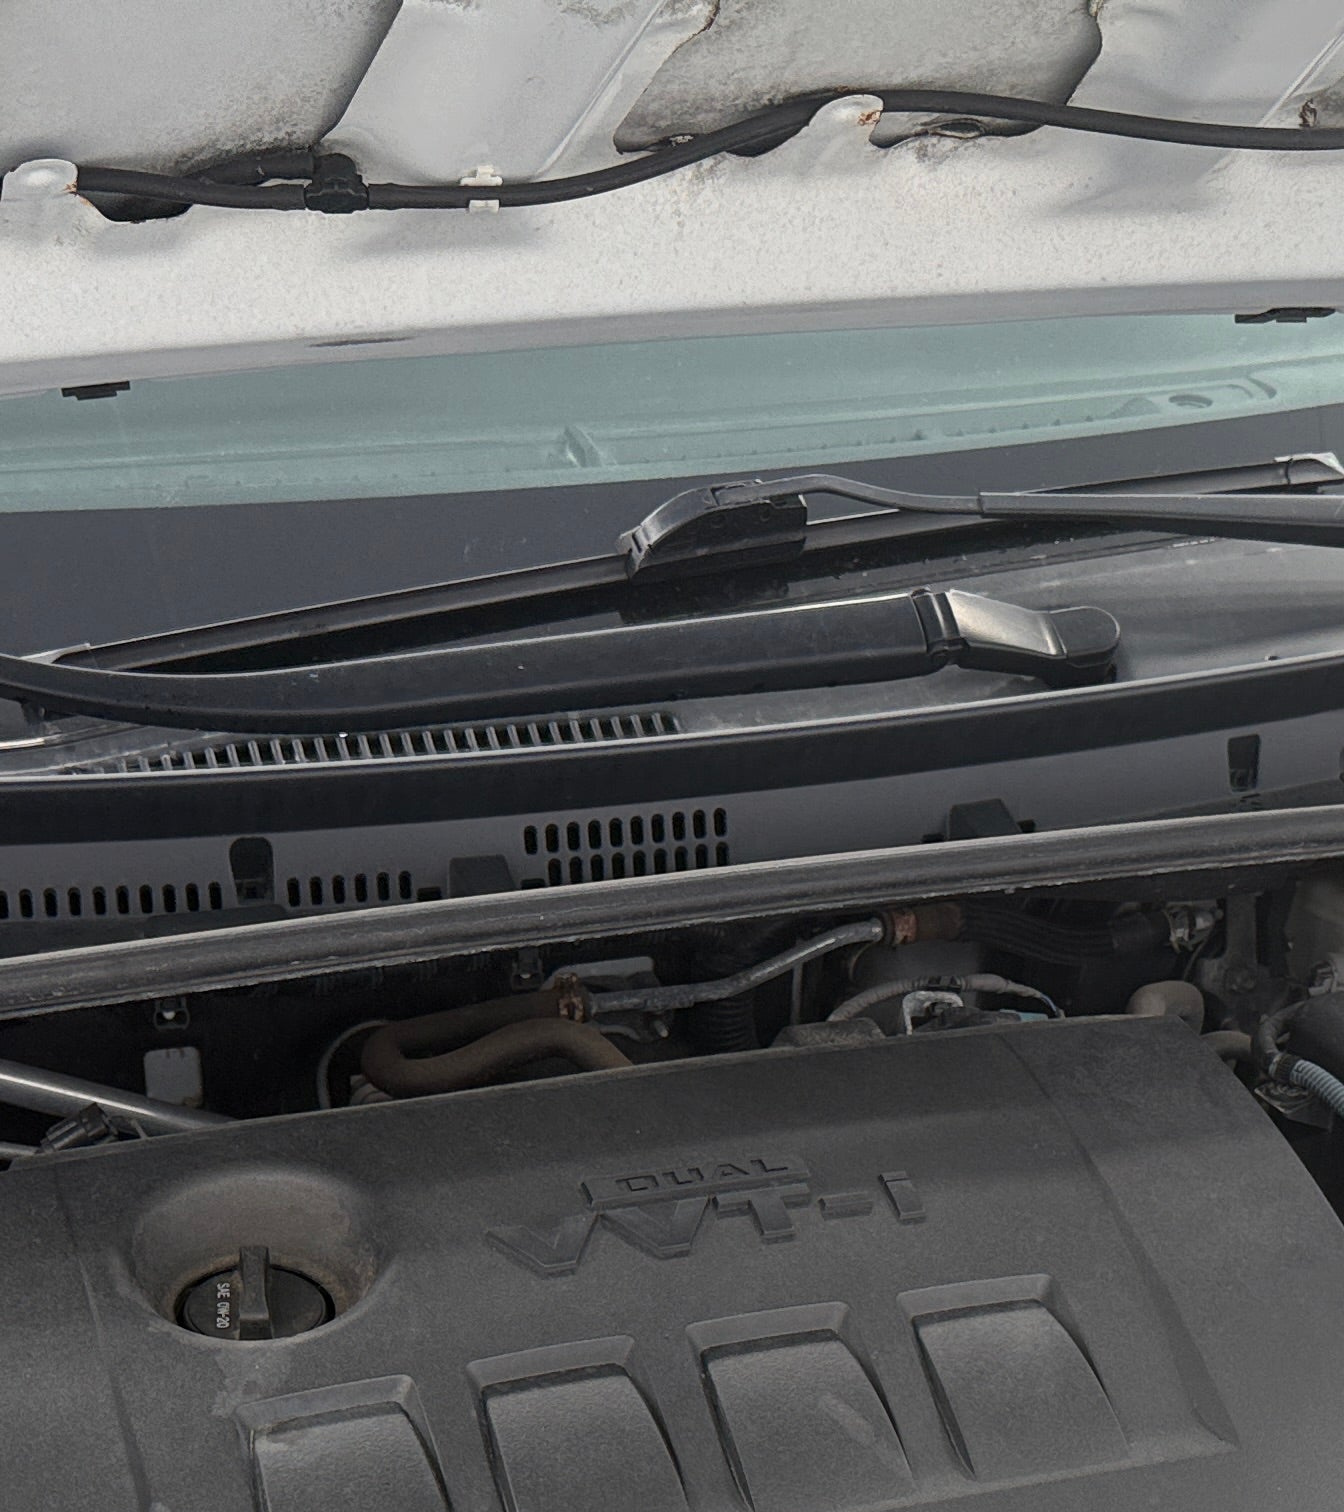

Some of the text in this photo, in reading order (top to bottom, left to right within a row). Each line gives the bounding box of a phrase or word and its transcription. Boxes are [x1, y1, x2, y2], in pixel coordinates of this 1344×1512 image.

[615, 1158, 790, 1193] DUAL
[216, 1282, 230, 1329] SAE 0W-20
